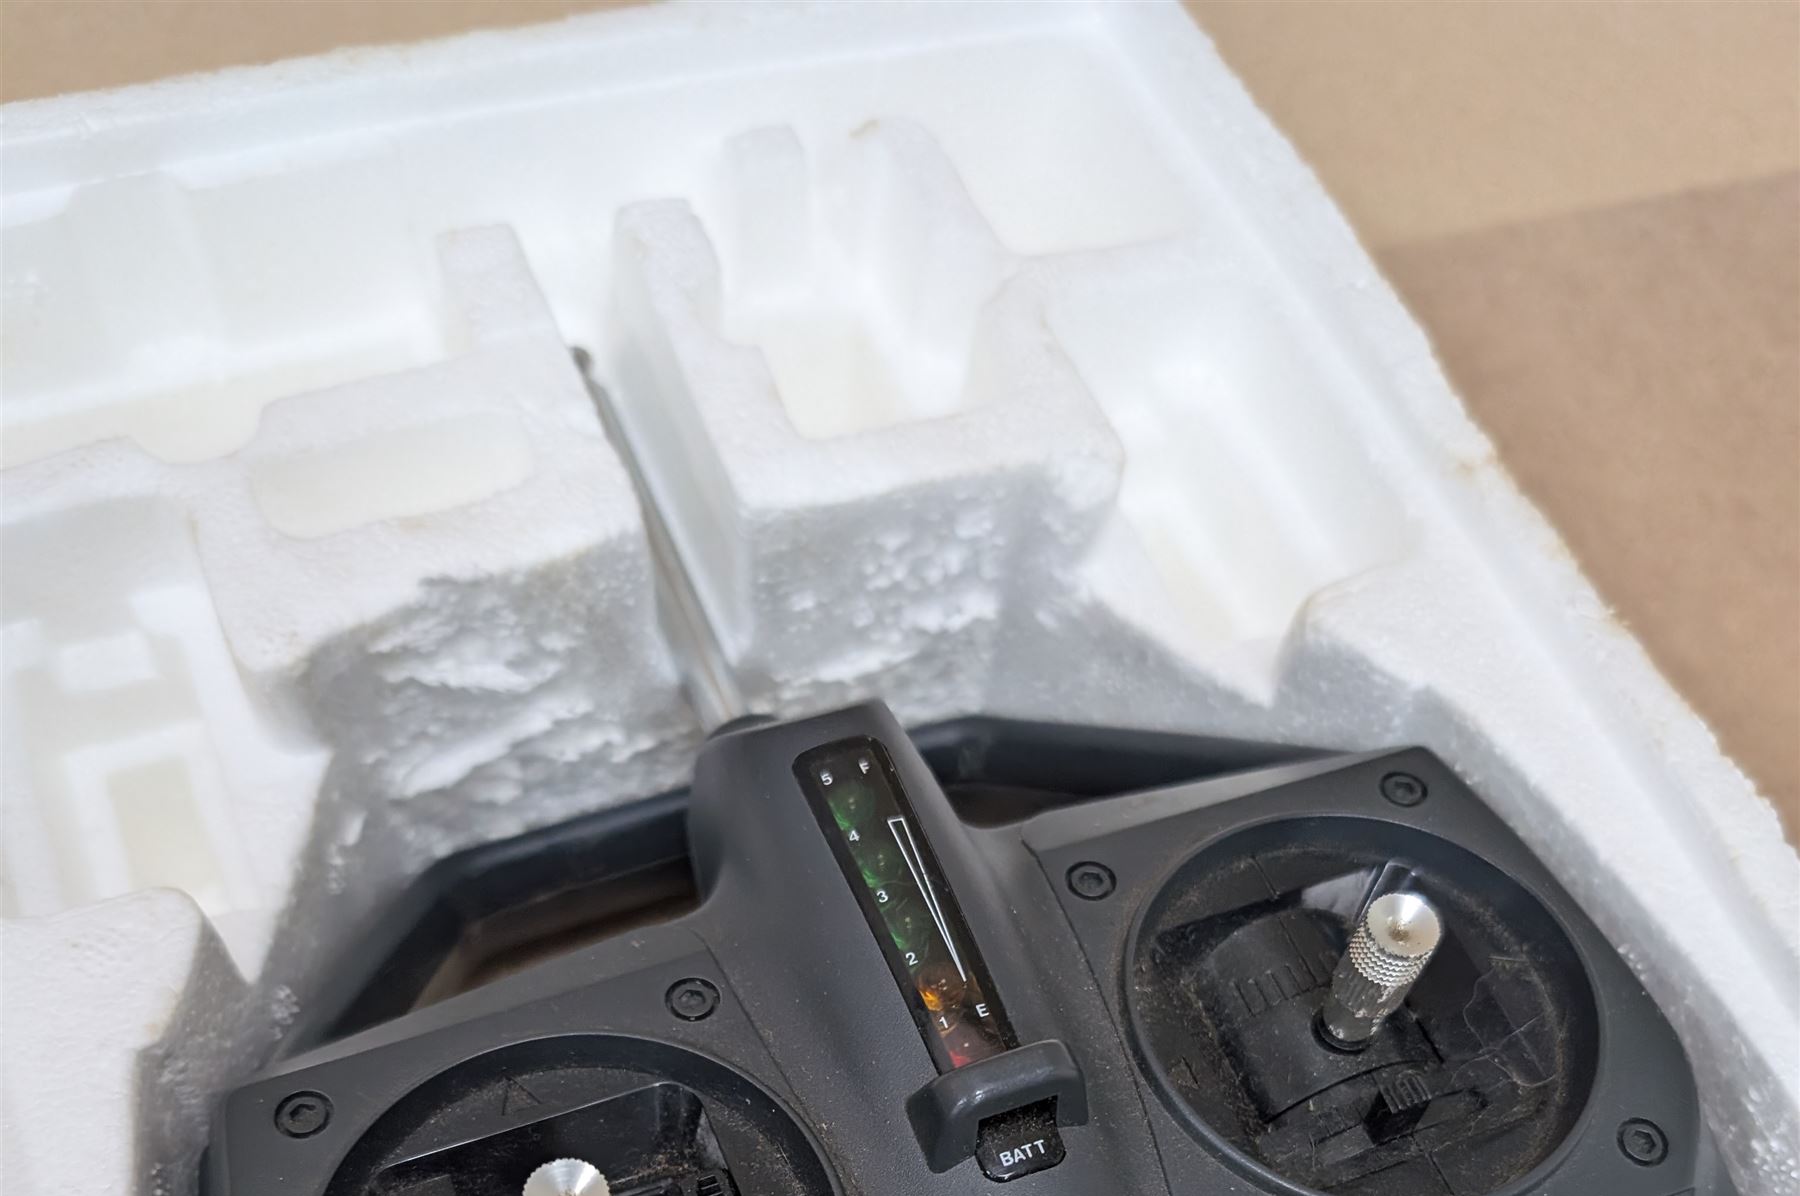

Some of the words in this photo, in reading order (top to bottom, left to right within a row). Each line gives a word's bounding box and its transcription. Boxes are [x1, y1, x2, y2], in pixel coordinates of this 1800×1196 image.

[820, 771, 833, 786] 5
[859, 760, 870, 775] F
[849, 829, 860, 842] 4
[876, 889, 889, 903] 3
[905, 951, 919, 966] 2
[939, 1015, 949, 1029] 1
[975, 1002, 990, 1018] E
[999, 1138, 1046, 1168] BATT
